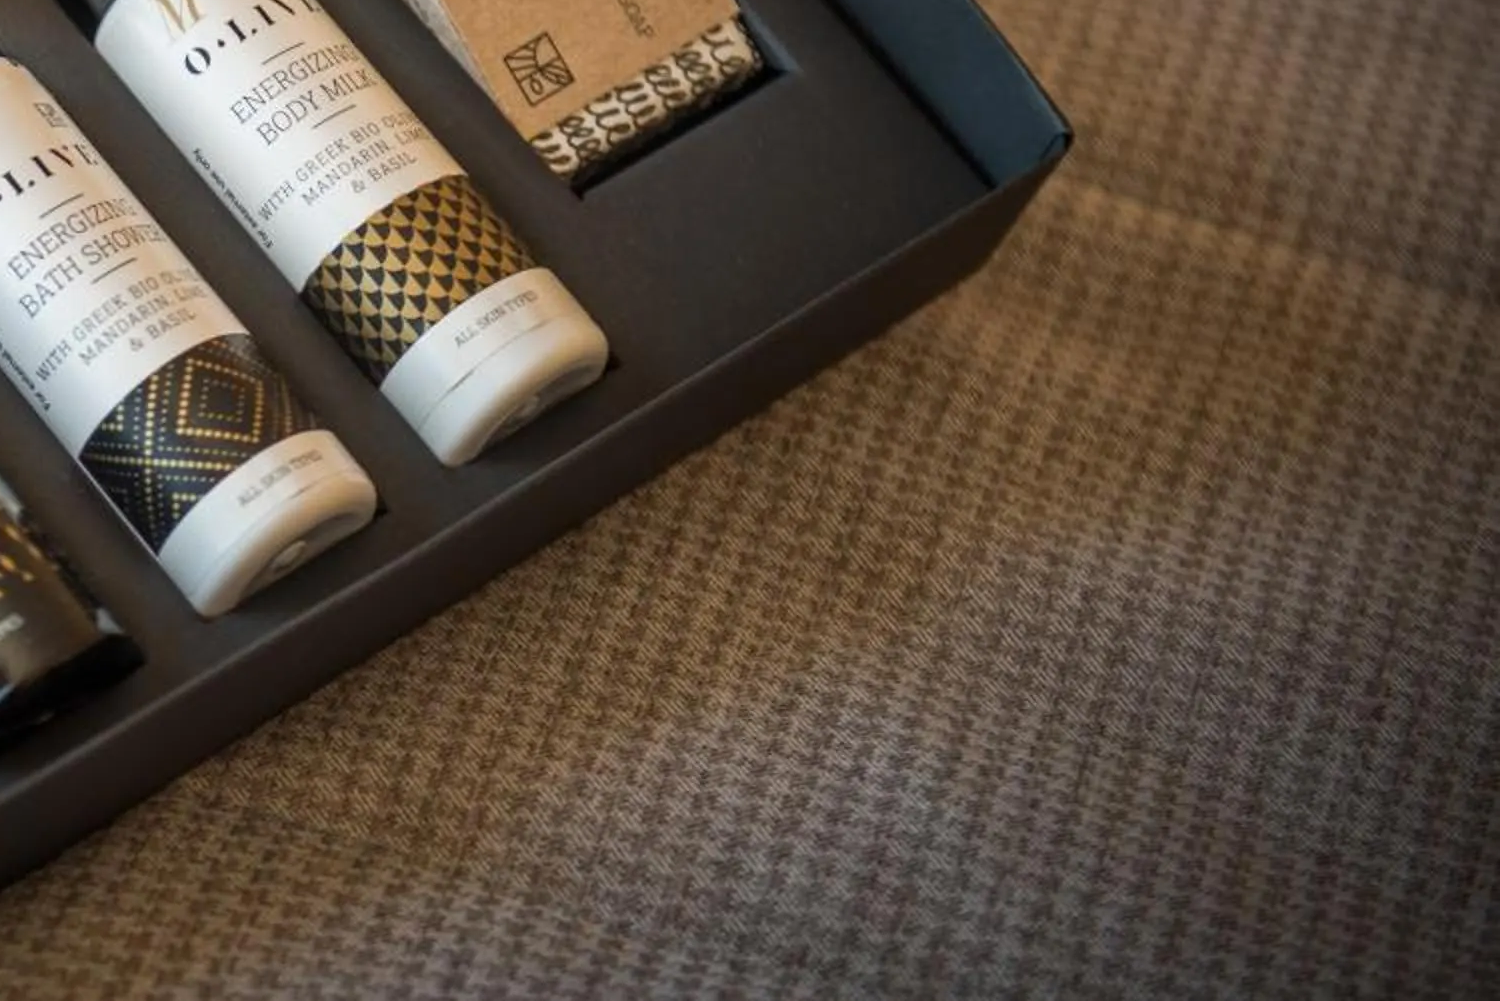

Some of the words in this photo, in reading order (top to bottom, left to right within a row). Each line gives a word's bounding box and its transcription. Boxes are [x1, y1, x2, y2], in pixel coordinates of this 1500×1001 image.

[230, 42, 361, 125] ENERGIZING
[256, 89, 319, 147] BODY
[319, 67, 379, 103] MILK
[257, 180, 296, 222] WITH
[294, 136, 350, 183] GREEK
[349, 121, 382, 145] BIO
[350, 179, 367, 195] &
[366, 151, 418, 183] BASIL
[8, 197, 138, 281] ENERGIZING
[18, 256, 84, 320] BATH
[454, 325, 480, 350] ALL
[476, 304, 507, 331] SKIN
[34, 339, 73, 382] WITH
[72, 293, 129, 343] GREEK
[127, 275, 160, 300] BIO
[129, 336, 145, 353] &
[145, 307, 198, 341] BASIL
